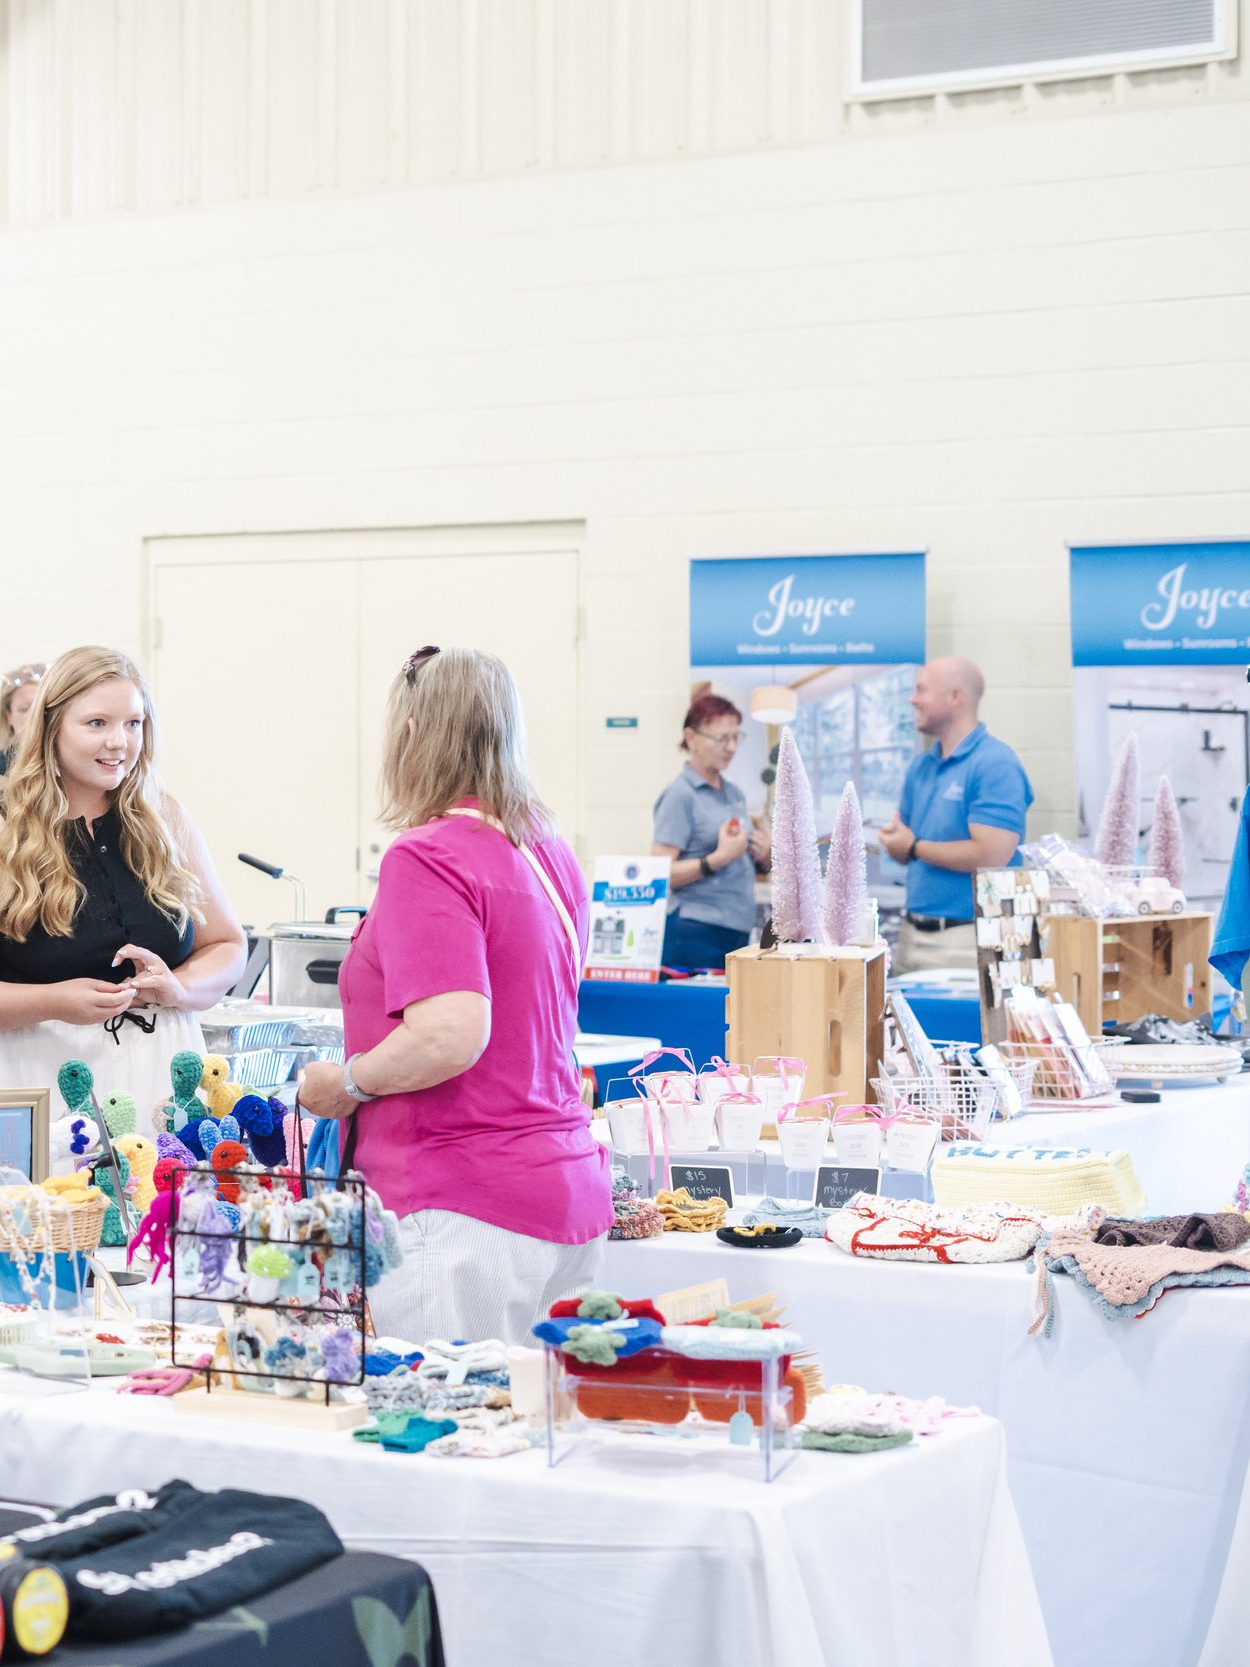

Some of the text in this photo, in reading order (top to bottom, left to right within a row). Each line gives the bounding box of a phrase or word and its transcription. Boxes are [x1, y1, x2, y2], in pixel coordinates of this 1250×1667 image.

[752, 574, 855, 637] Joyce
[1140, 562, 1250, 631] Joyce
[685, 1169, 707, 1182] $15
[830, 1170, 849, 1184] $7
